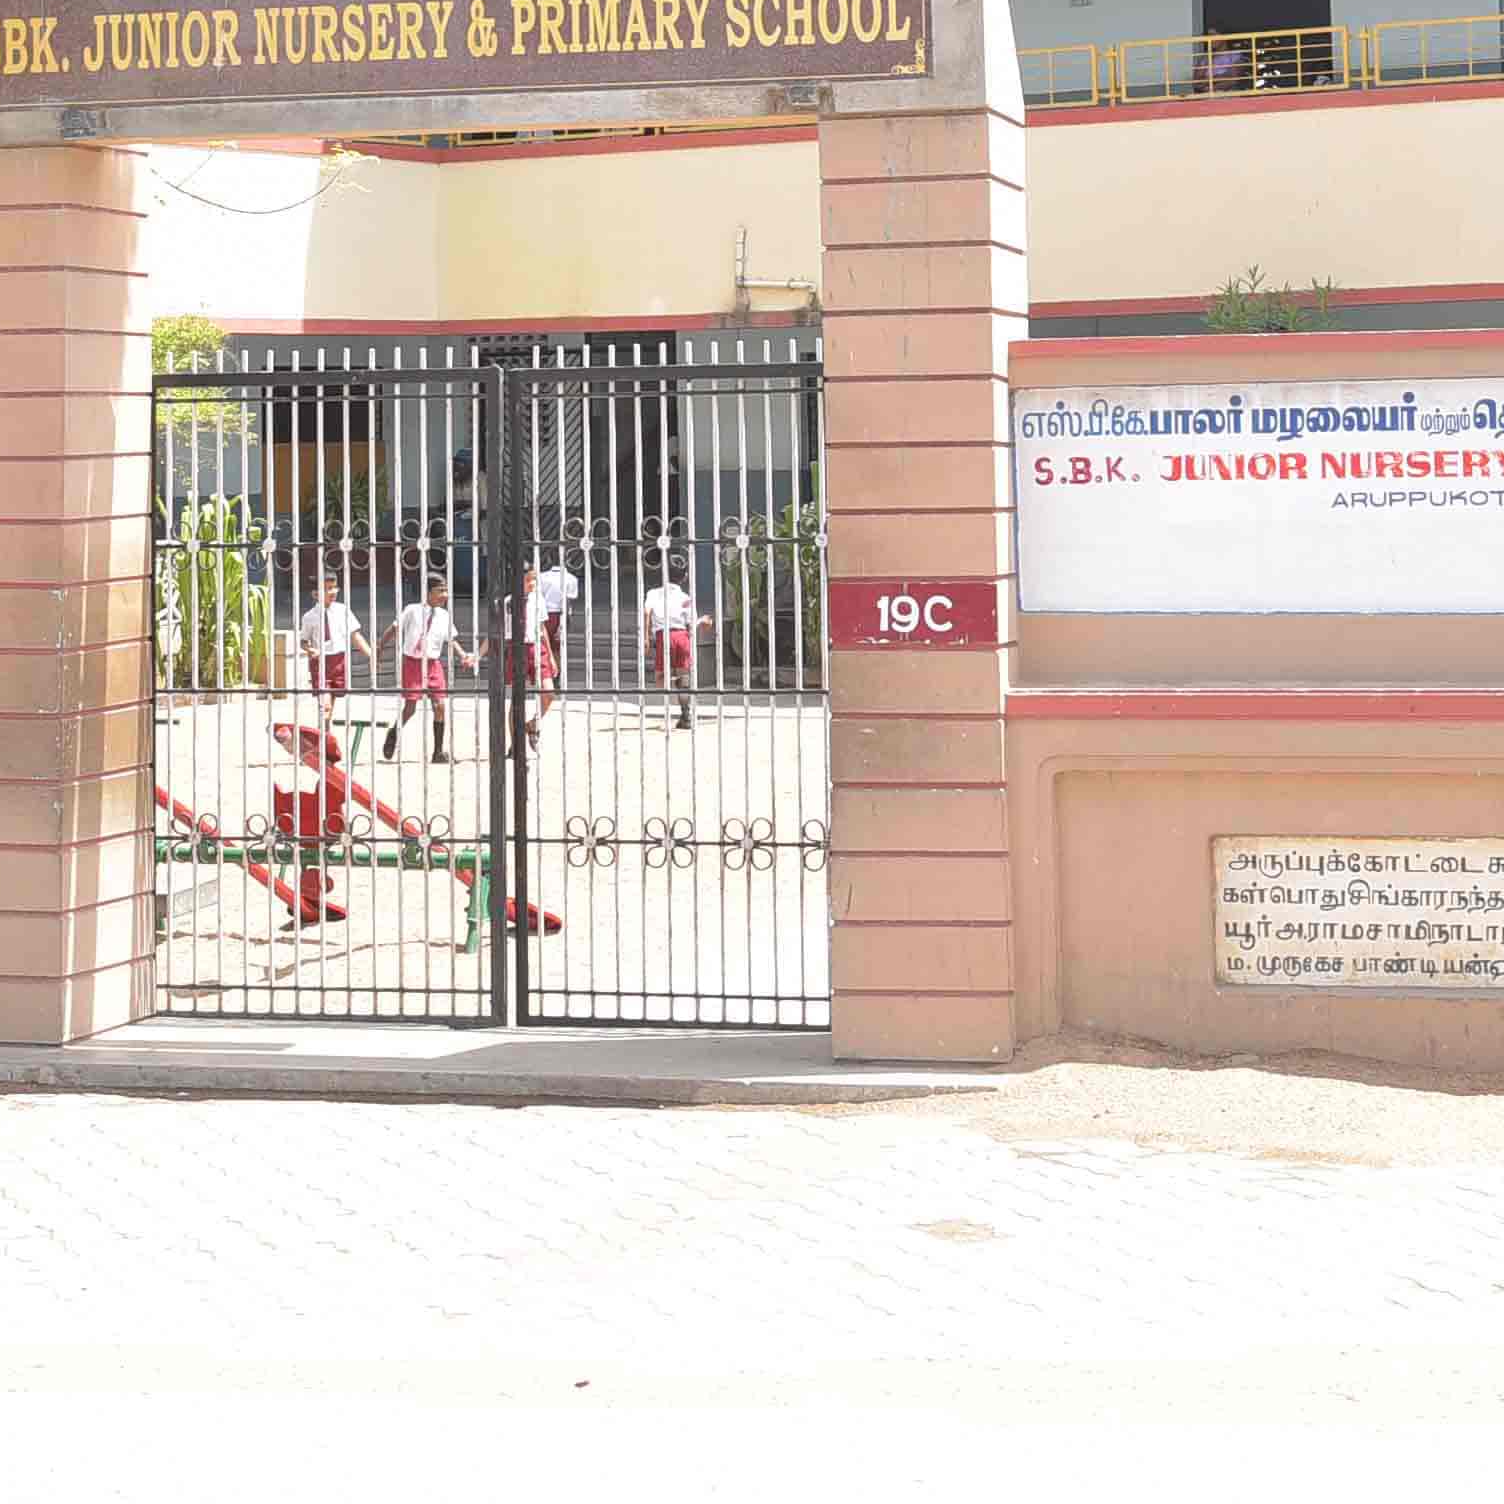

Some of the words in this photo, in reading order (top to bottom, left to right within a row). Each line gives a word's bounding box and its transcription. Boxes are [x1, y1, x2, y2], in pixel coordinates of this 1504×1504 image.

[83, 9, 242, 72] JUNIOR
[253, 0, 455, 66] NURSERY
[1251, 391, 1418, 442] மழலையர்
[1160, 450, 1308, 481] JUNIOR
[876, 594, 954, 634] 19C
